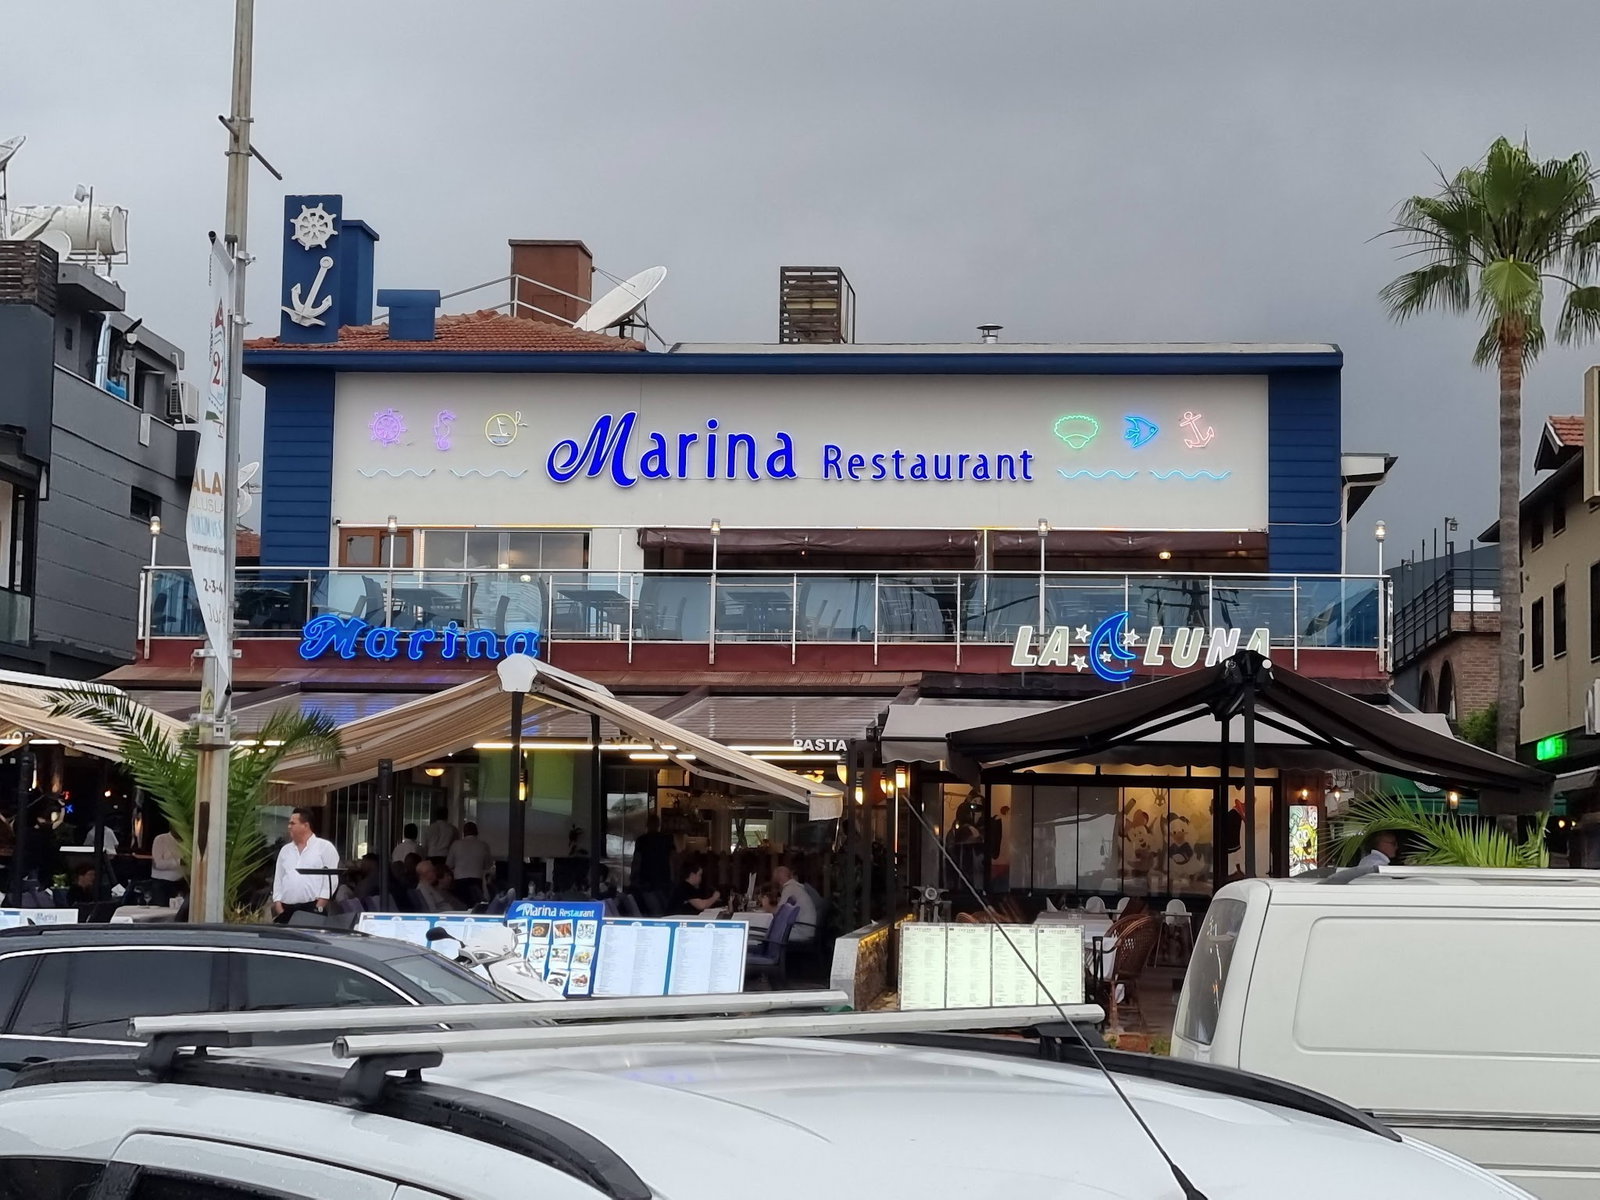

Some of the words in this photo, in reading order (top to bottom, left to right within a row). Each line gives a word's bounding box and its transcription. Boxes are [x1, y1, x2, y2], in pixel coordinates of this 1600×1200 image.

[545, 410, 797, 489] Marina
[822, 443, 1034, 483] Restaurant
[192, 467, 223, 496] ALA
[299, 613, 542, 661] Marina
[1011, 626, 1069, 667] LA
[1143, 626, 1270, 668] LUNA
[793, 738, 848, 752] PASTA
[522, 904, 557, 917] Marina
[559, 908, 595, 918] Restaurant
